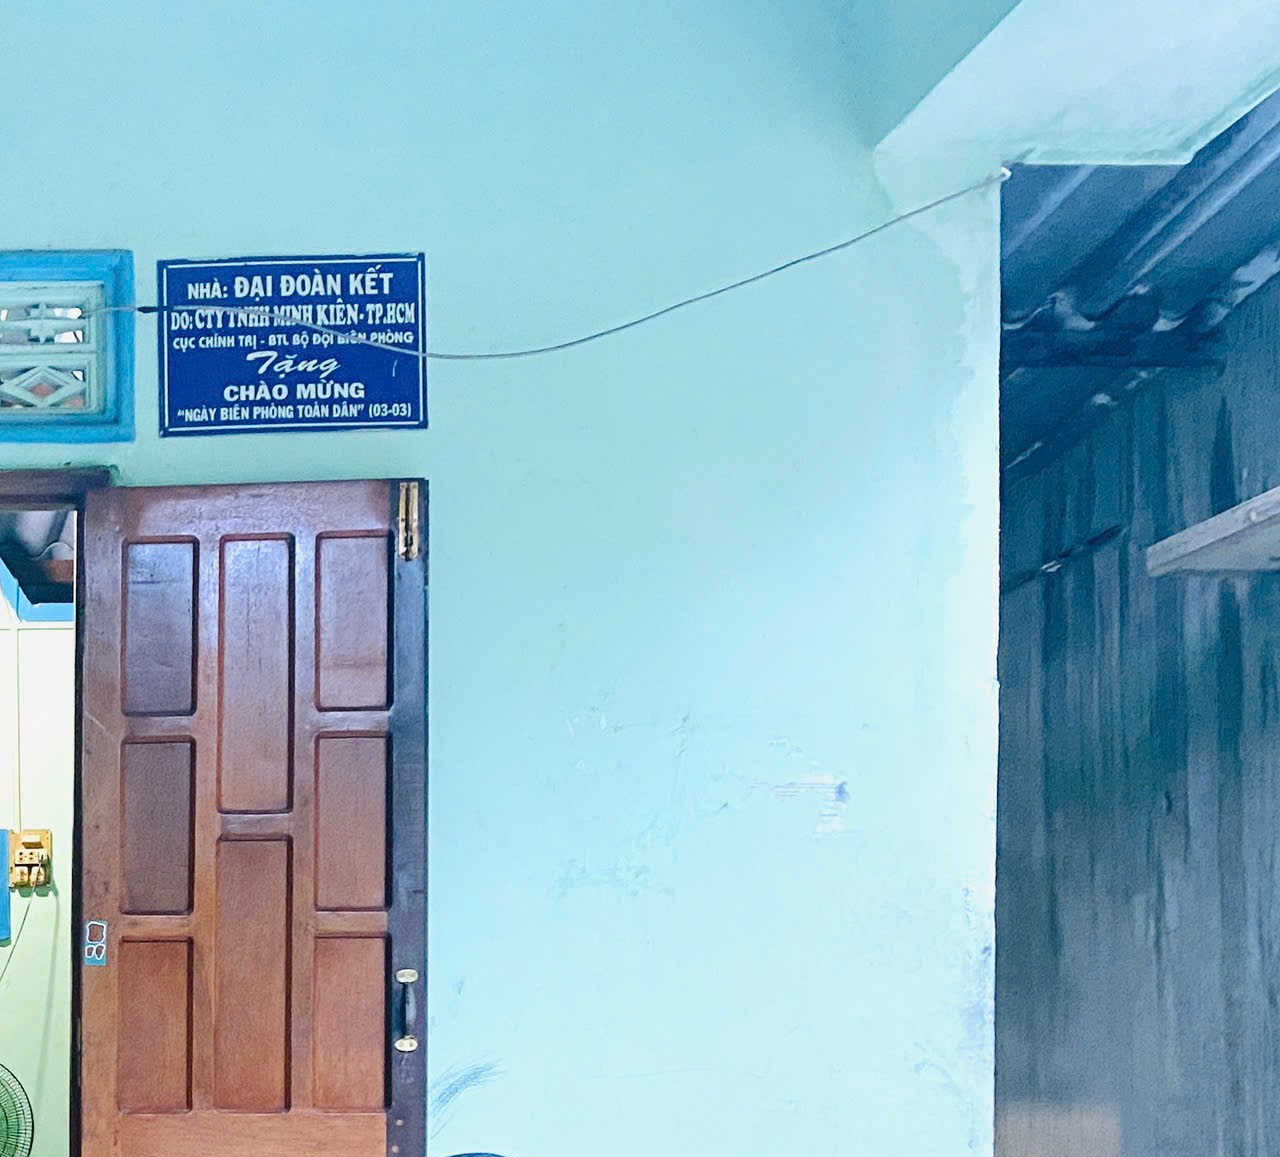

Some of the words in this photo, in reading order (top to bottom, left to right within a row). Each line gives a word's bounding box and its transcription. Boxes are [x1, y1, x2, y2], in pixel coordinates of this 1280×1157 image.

[187, 277, 228, 300] NHÀ:
[234, 275, 273, 302] ĐẠI
[280, 268, 341, 297] ĐOÀN
[349, 264, 394, 295] KẾT
[194, 308, 223, 329] CTY
[273, 303, 313, 327] MINH
[173, 337, 196, 352] CỤC
[199, 333, 235, 348] CHÍNH
[238, 334, 257, 350] TRỊ
[268, 334, 289, 346] BTL
[292, 331, 309, 349] BỘ
[312, 331, 334, 349] ĐỘI
[370, 329, 414, 344] PHÒNG
[246, 350, 341, 379] Tặng
[223, 380, 288, 402] CHÀO
[296, 379, 365, 400] MỪNG
[220, 403, 250, 421] BIÊN
[253, 402, 294, 420] PHÒNG
[296, 401, 329, 418] TOÀN
[368, 402, 412, 418] (03-03)
